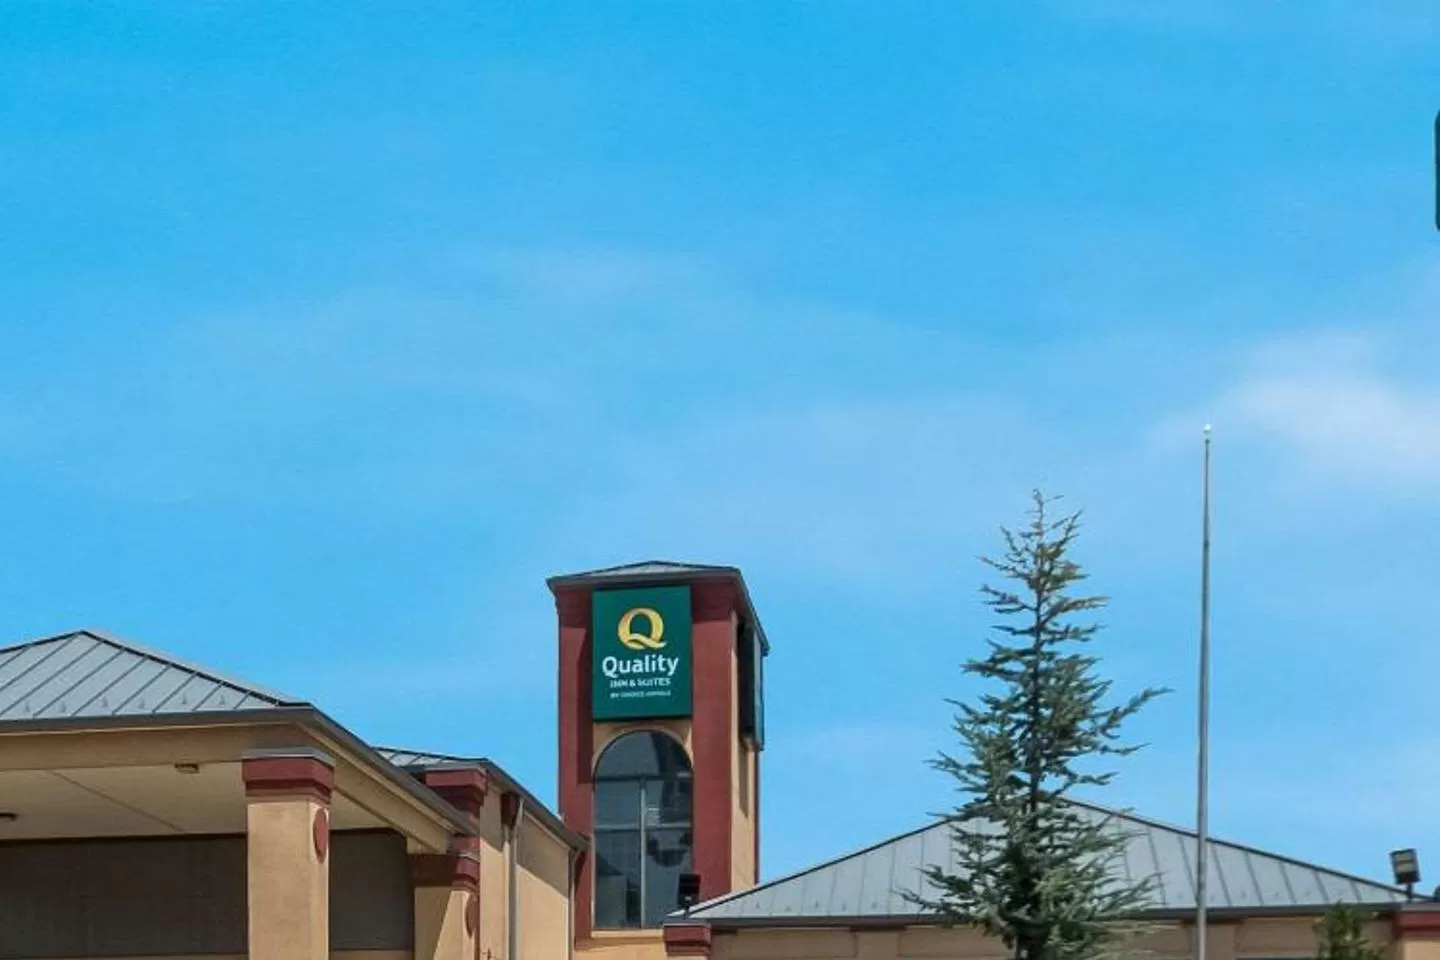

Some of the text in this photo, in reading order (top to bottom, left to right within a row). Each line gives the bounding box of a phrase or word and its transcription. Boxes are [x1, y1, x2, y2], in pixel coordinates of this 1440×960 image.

[618, 608, 667, 650] Q
[602, 654, 679, 678] Quality
[610, 677, 672, 689] INN & SUITES
